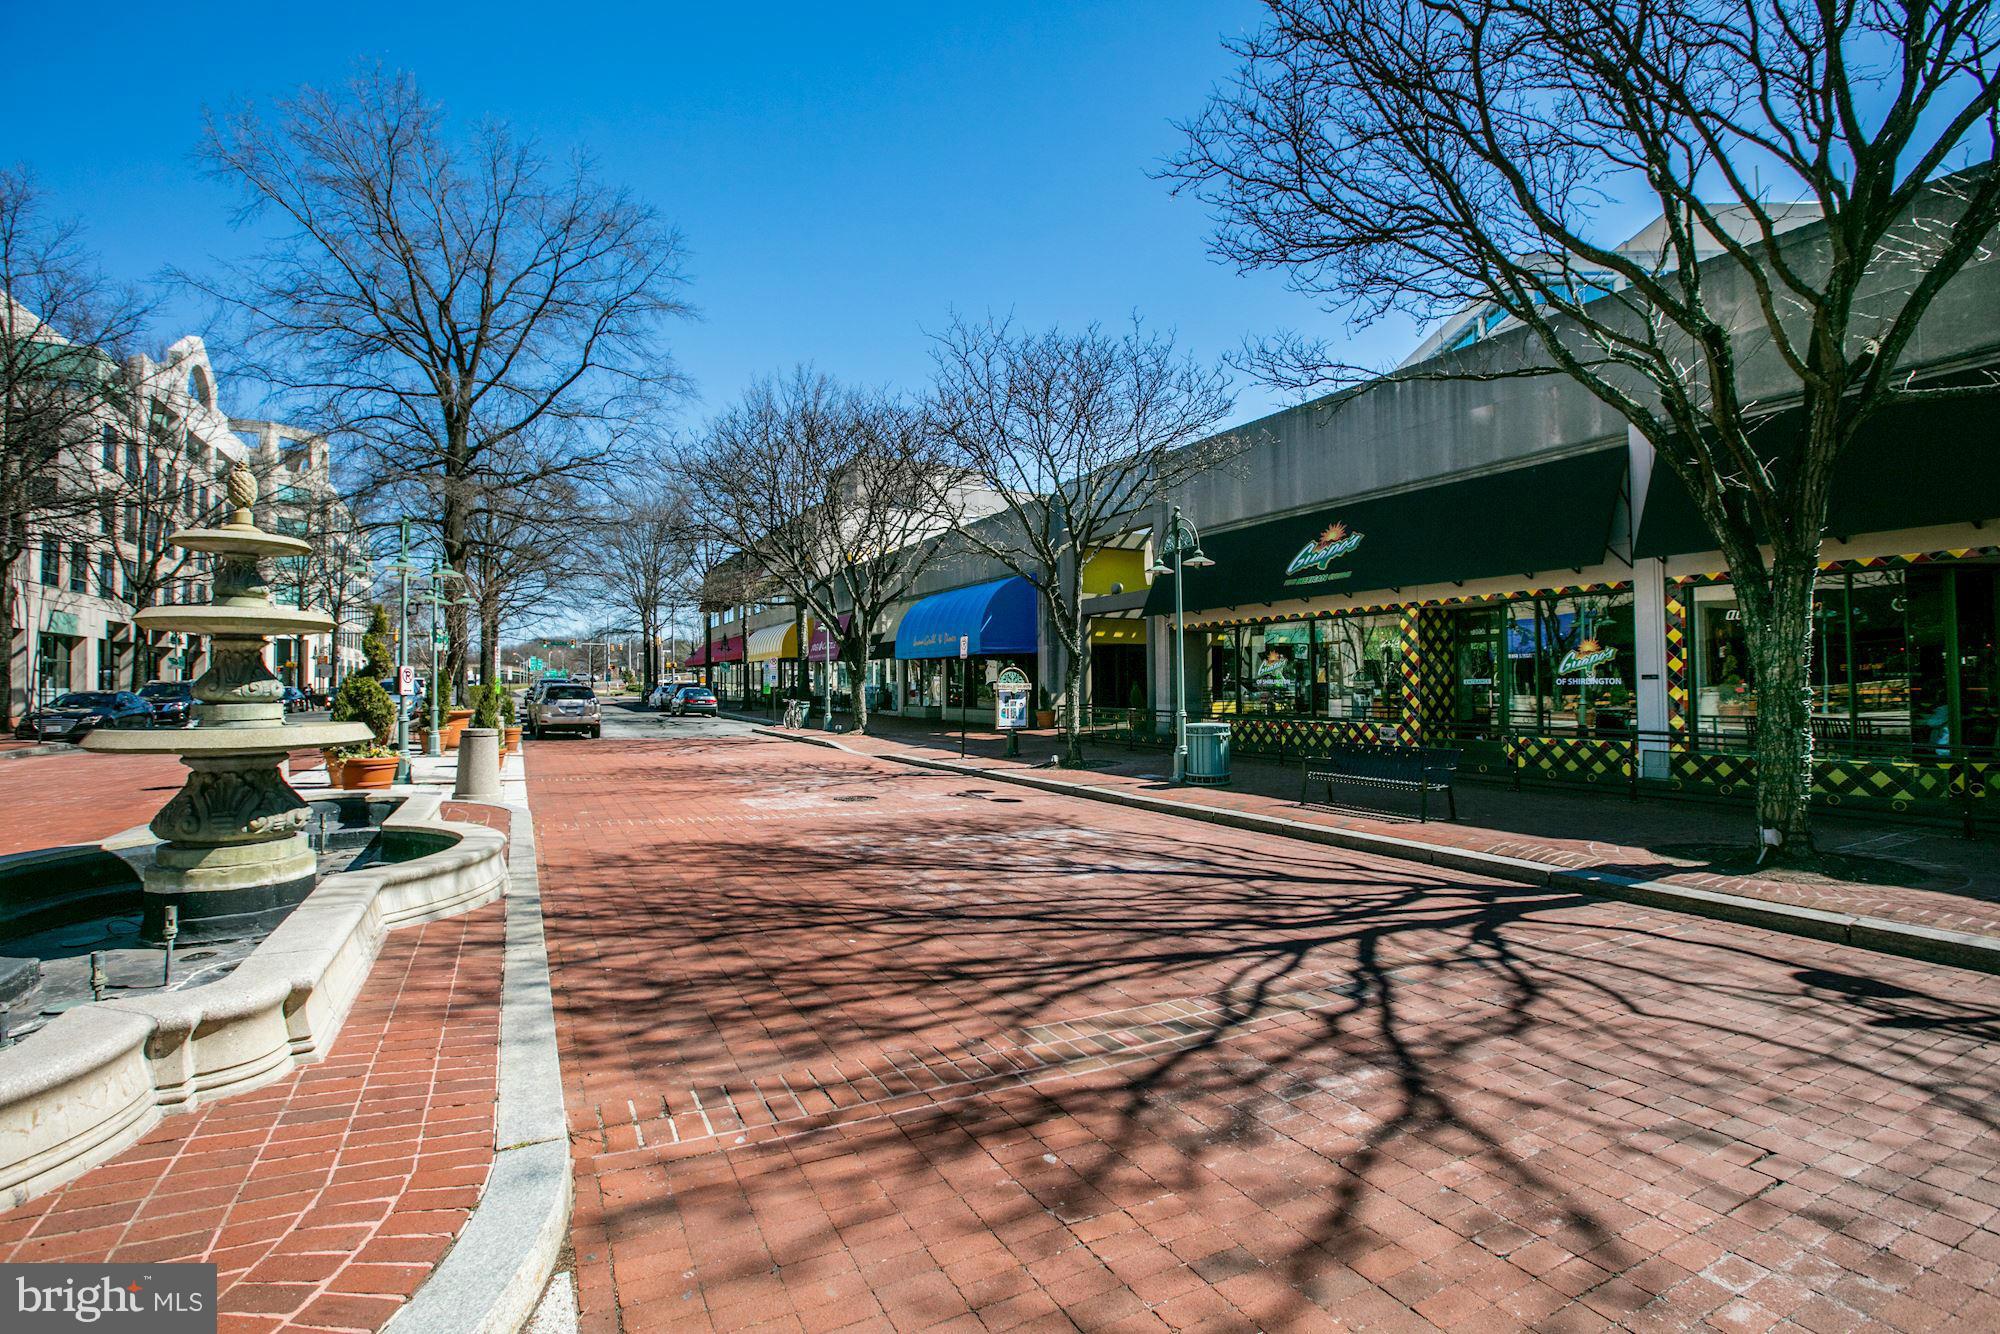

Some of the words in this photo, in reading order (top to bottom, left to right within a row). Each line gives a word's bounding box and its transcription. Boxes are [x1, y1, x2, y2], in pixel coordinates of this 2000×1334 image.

[1286, 533, 1362, 573] Guapo's
[1558, 647, 1616, 674] Guapo's
[1555, 678, 1567, 686] OF
[1568, 677, 1622, 686] SHIRLINGTON
